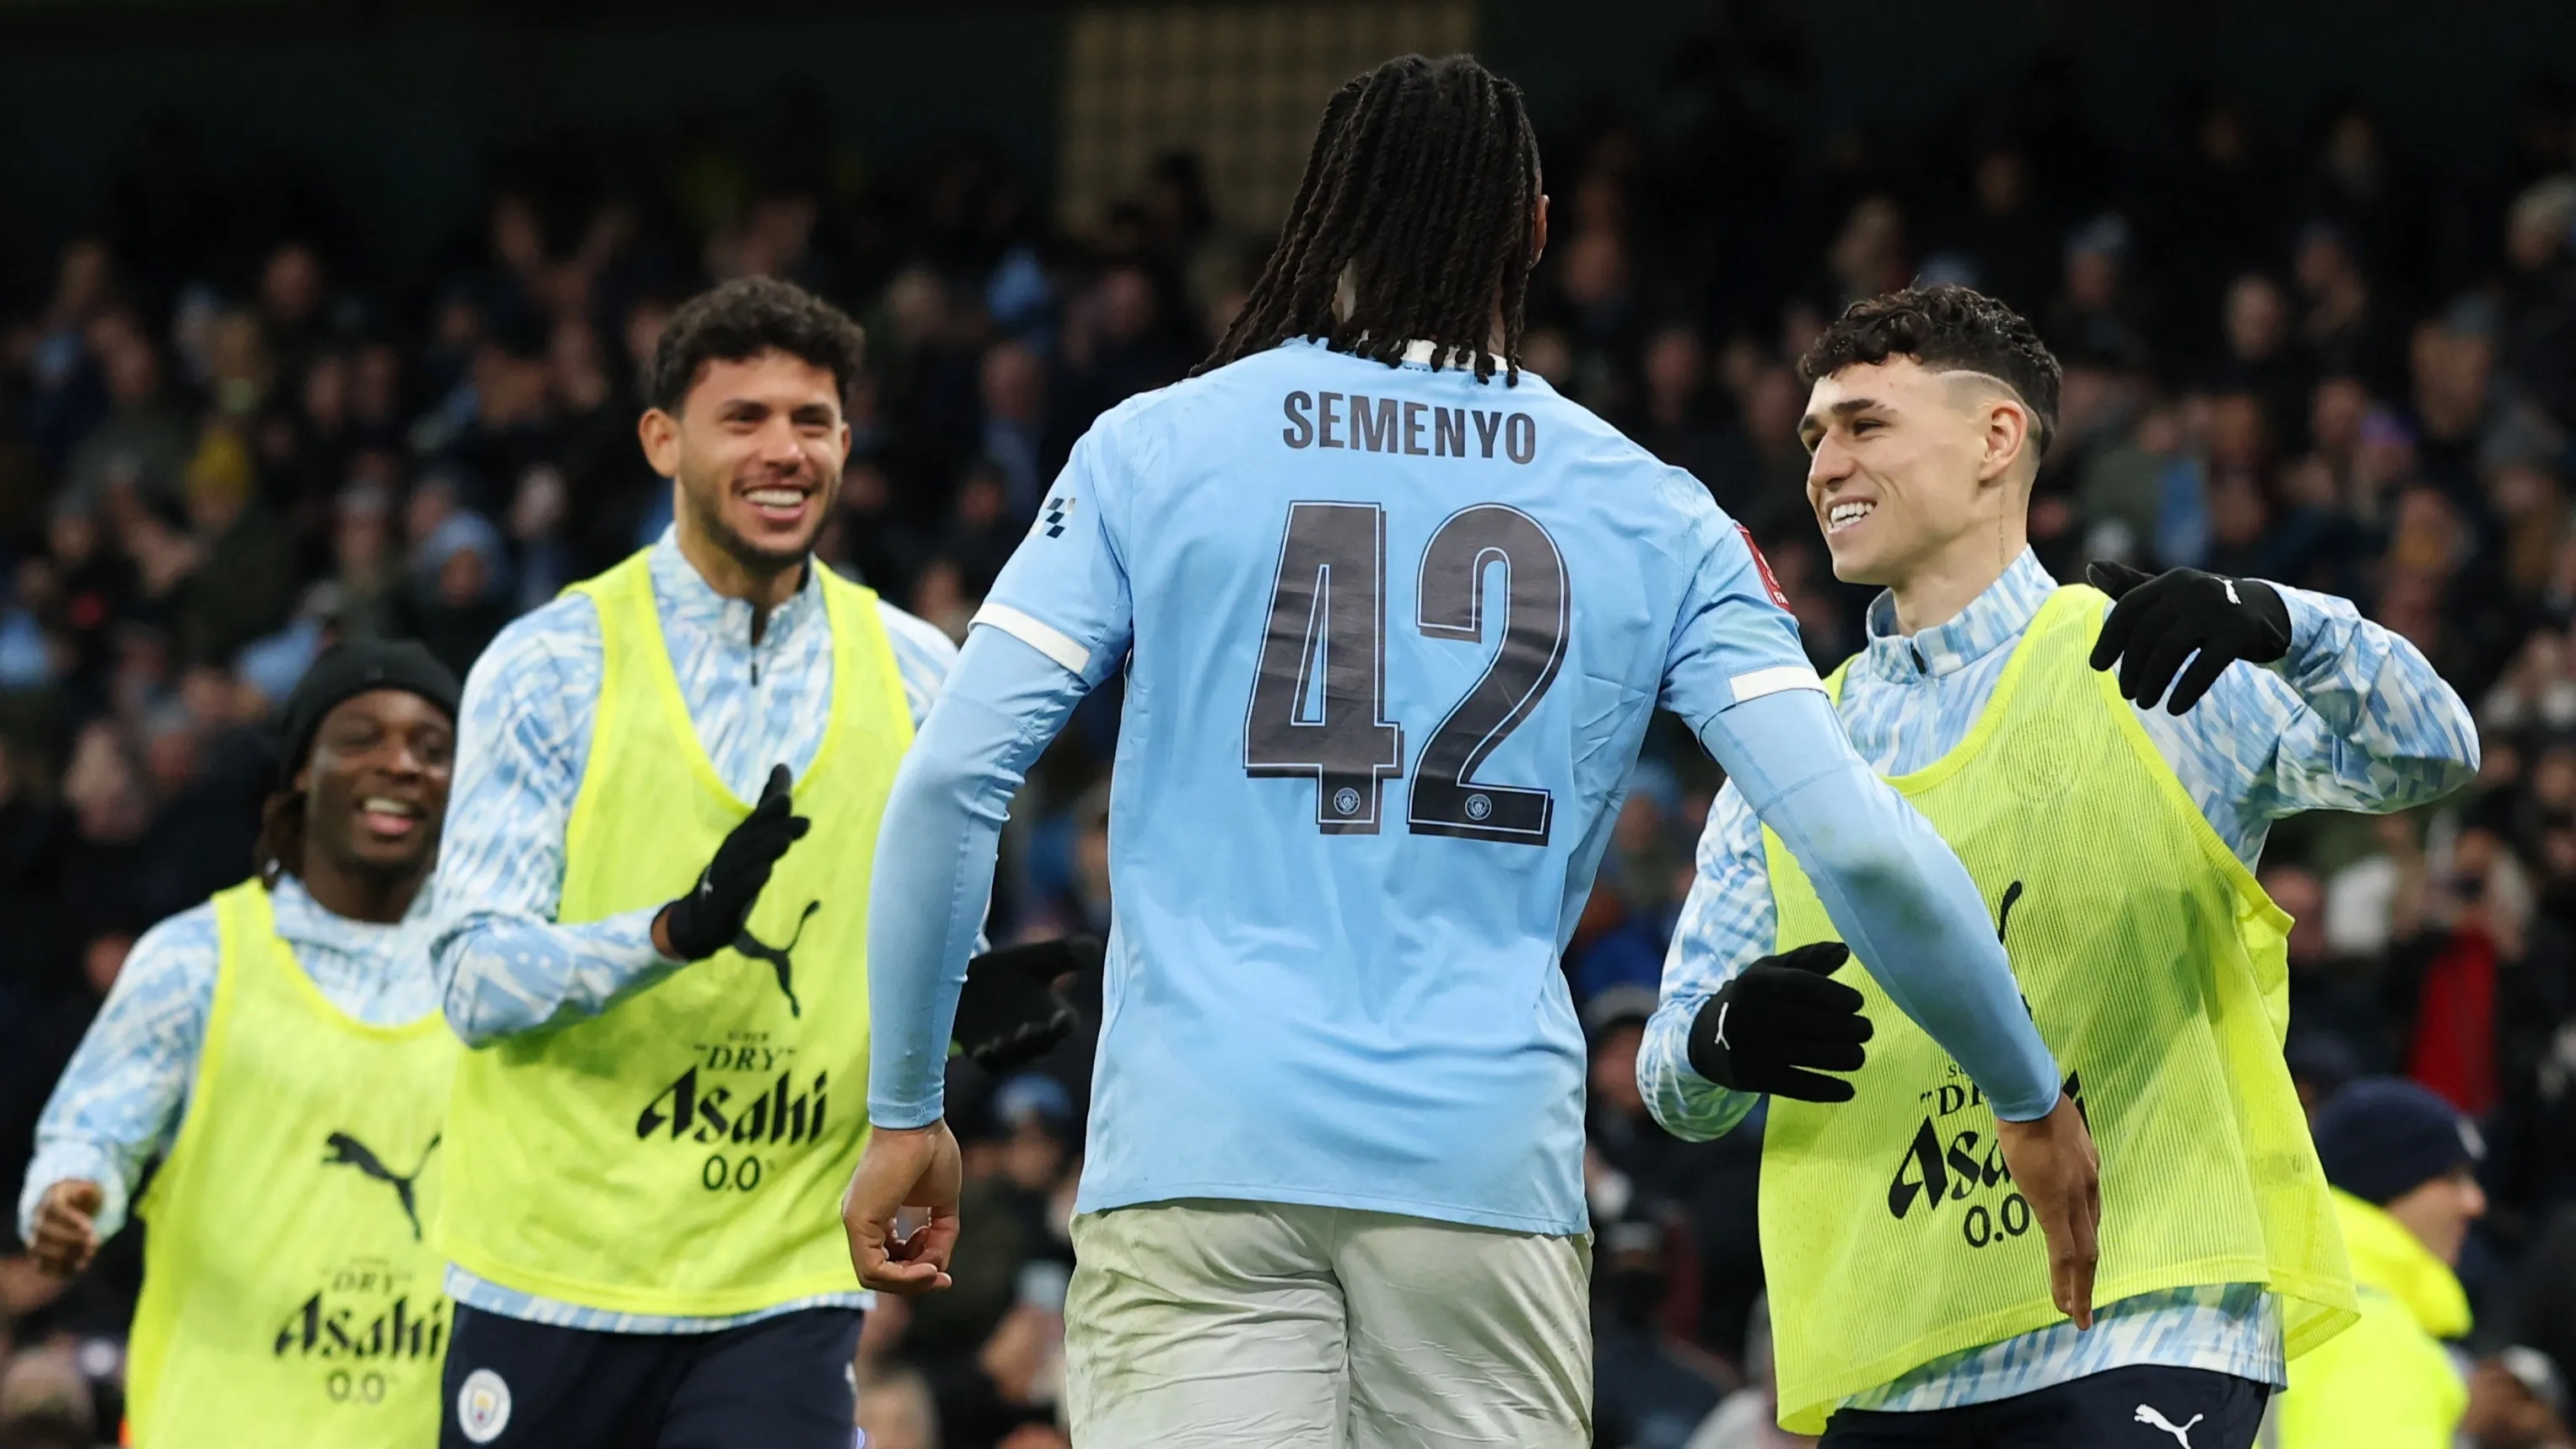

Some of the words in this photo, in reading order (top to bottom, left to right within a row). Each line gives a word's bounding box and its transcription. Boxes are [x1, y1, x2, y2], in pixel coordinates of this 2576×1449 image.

[1283, 390, 1536, 465] SEMENYO
[1242, 500, 1571, 848] 42
[637, 1065, 827, 1145] Asahi
[1963, 1193, 2030, 1248] 0.0
[273, 1290, 444, 1358] Asahi
